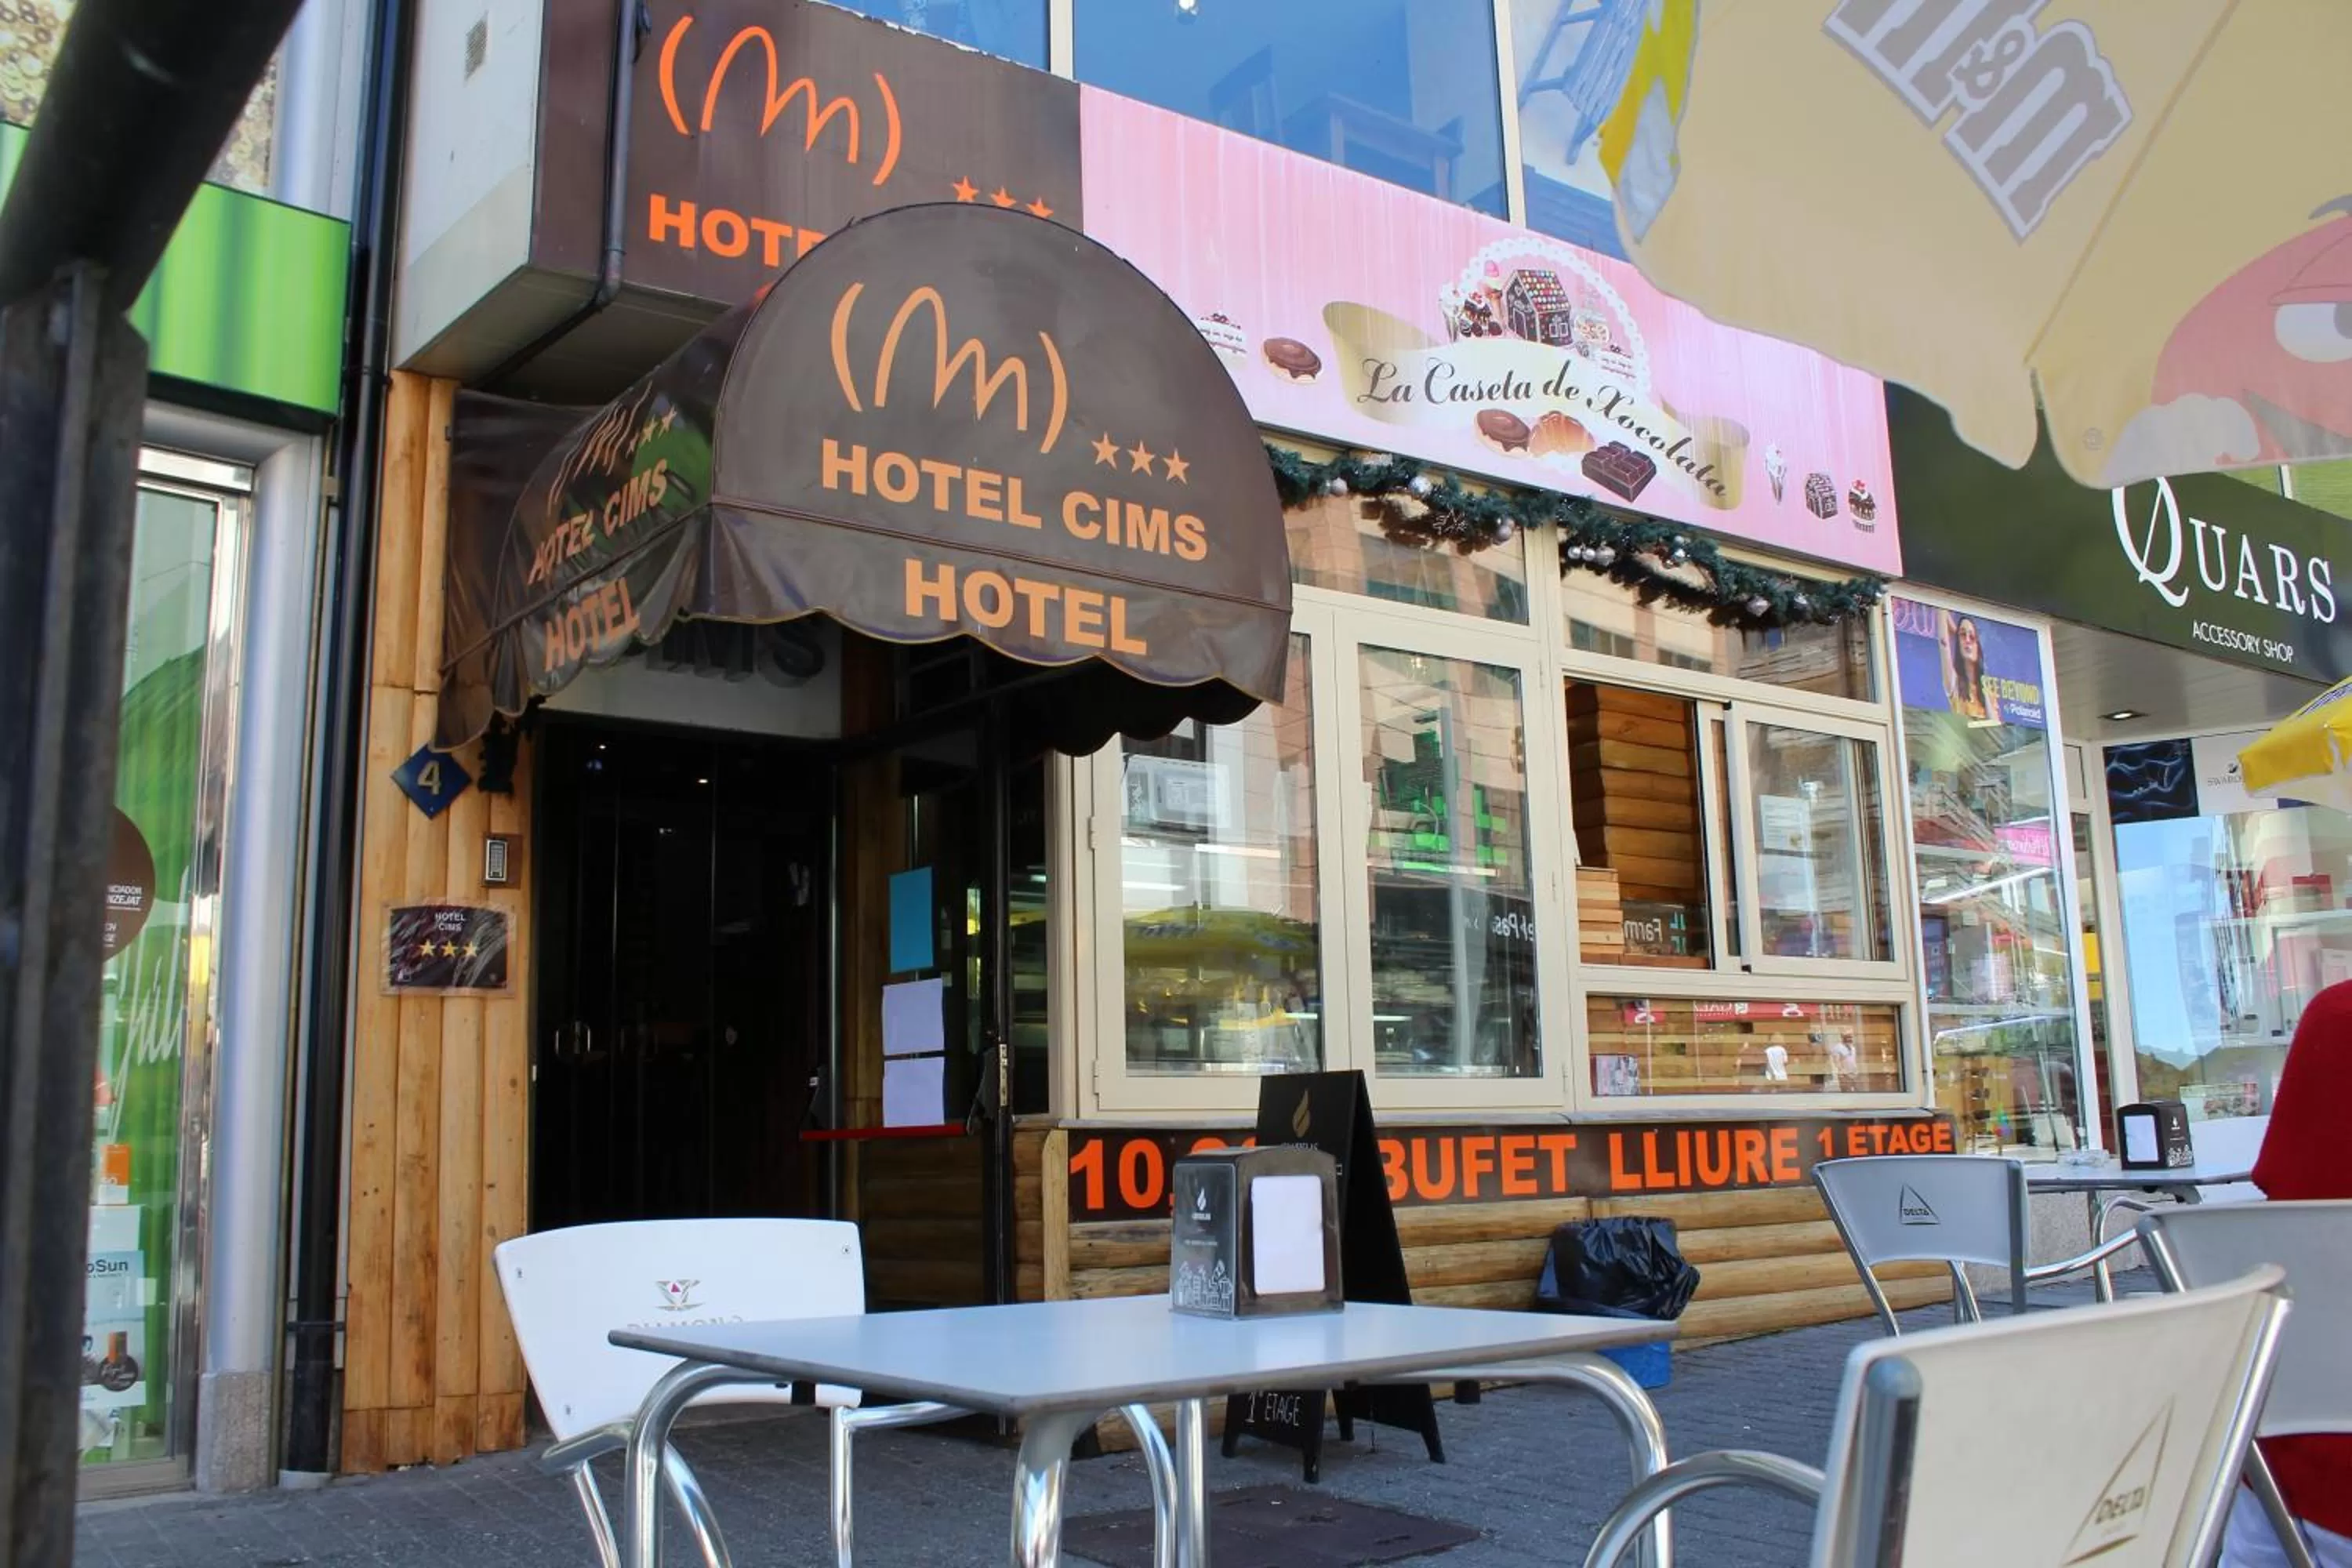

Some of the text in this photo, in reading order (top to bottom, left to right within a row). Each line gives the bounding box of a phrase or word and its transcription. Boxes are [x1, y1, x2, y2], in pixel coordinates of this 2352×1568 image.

[648, 194, 829, 267] HOT
[1356, 357, 1729, 497] La Caseta de Xocolata
[603, 458, 668, 537] CIMS
[822, 439, 1207, 561] HOTEL CIMS
[2111, 476, 2336, 624] QUARS
[544, 577, 641, 672] HOTEL
[906, 559, 1148, 655] HOTEL
[2193, 619, 2294, 663] ACCESSORY SHOP
[417, 760, 442, 796] 4
[435, 911, 466, 921] HOTEL
[438, 922, 463, 931] CIMS
[1377, 1134, 1577, 1200] BUFET
[1610, 1128, 1802, 1190] LLIURE
[1818, 1127, 1833, 1156] 1
[87, 1258, 129, 1274] oSun
